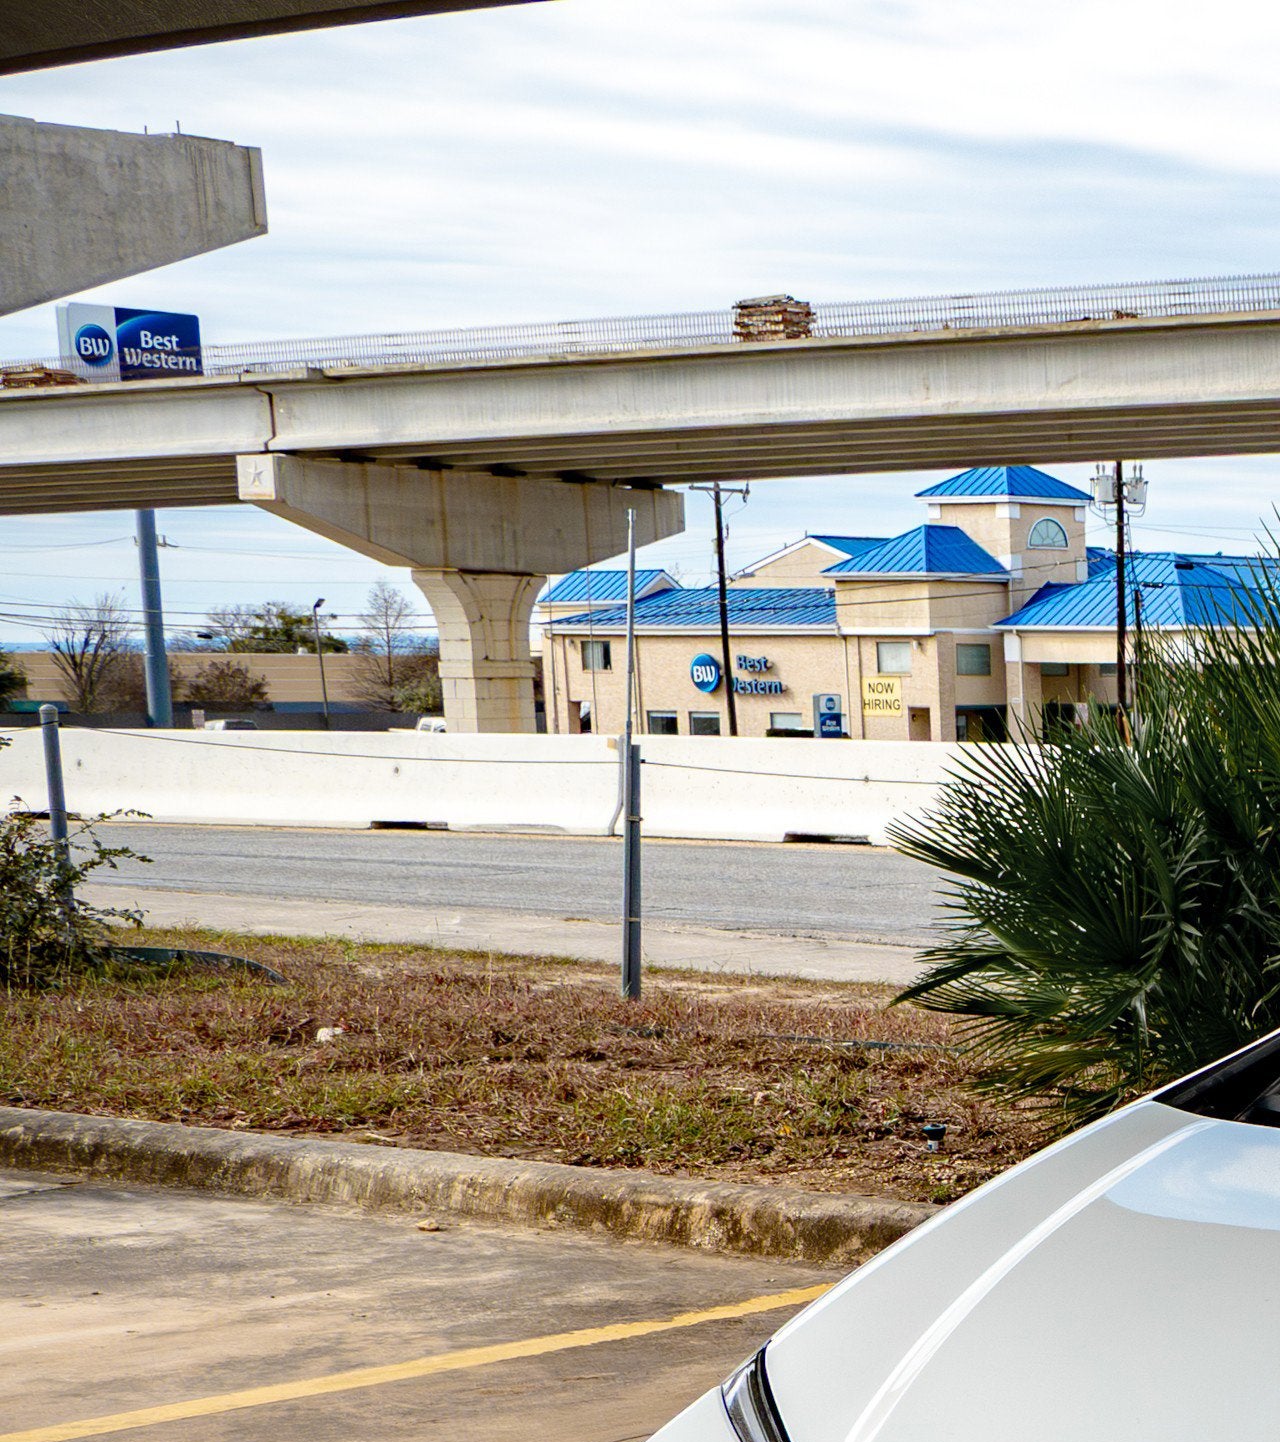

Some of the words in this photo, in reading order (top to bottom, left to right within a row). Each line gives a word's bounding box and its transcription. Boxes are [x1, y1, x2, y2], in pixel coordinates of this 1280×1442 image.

[79, 336, 110, 357] BW
[139, 330, 180, 351] Best
[123, 347, 197, 371] Western
[736, 655, 768, 672] Best
[692, 665, 716, 683] BW
[868, 682, 895, 694] NOW
[863, 698, 901, 711] HIRING
